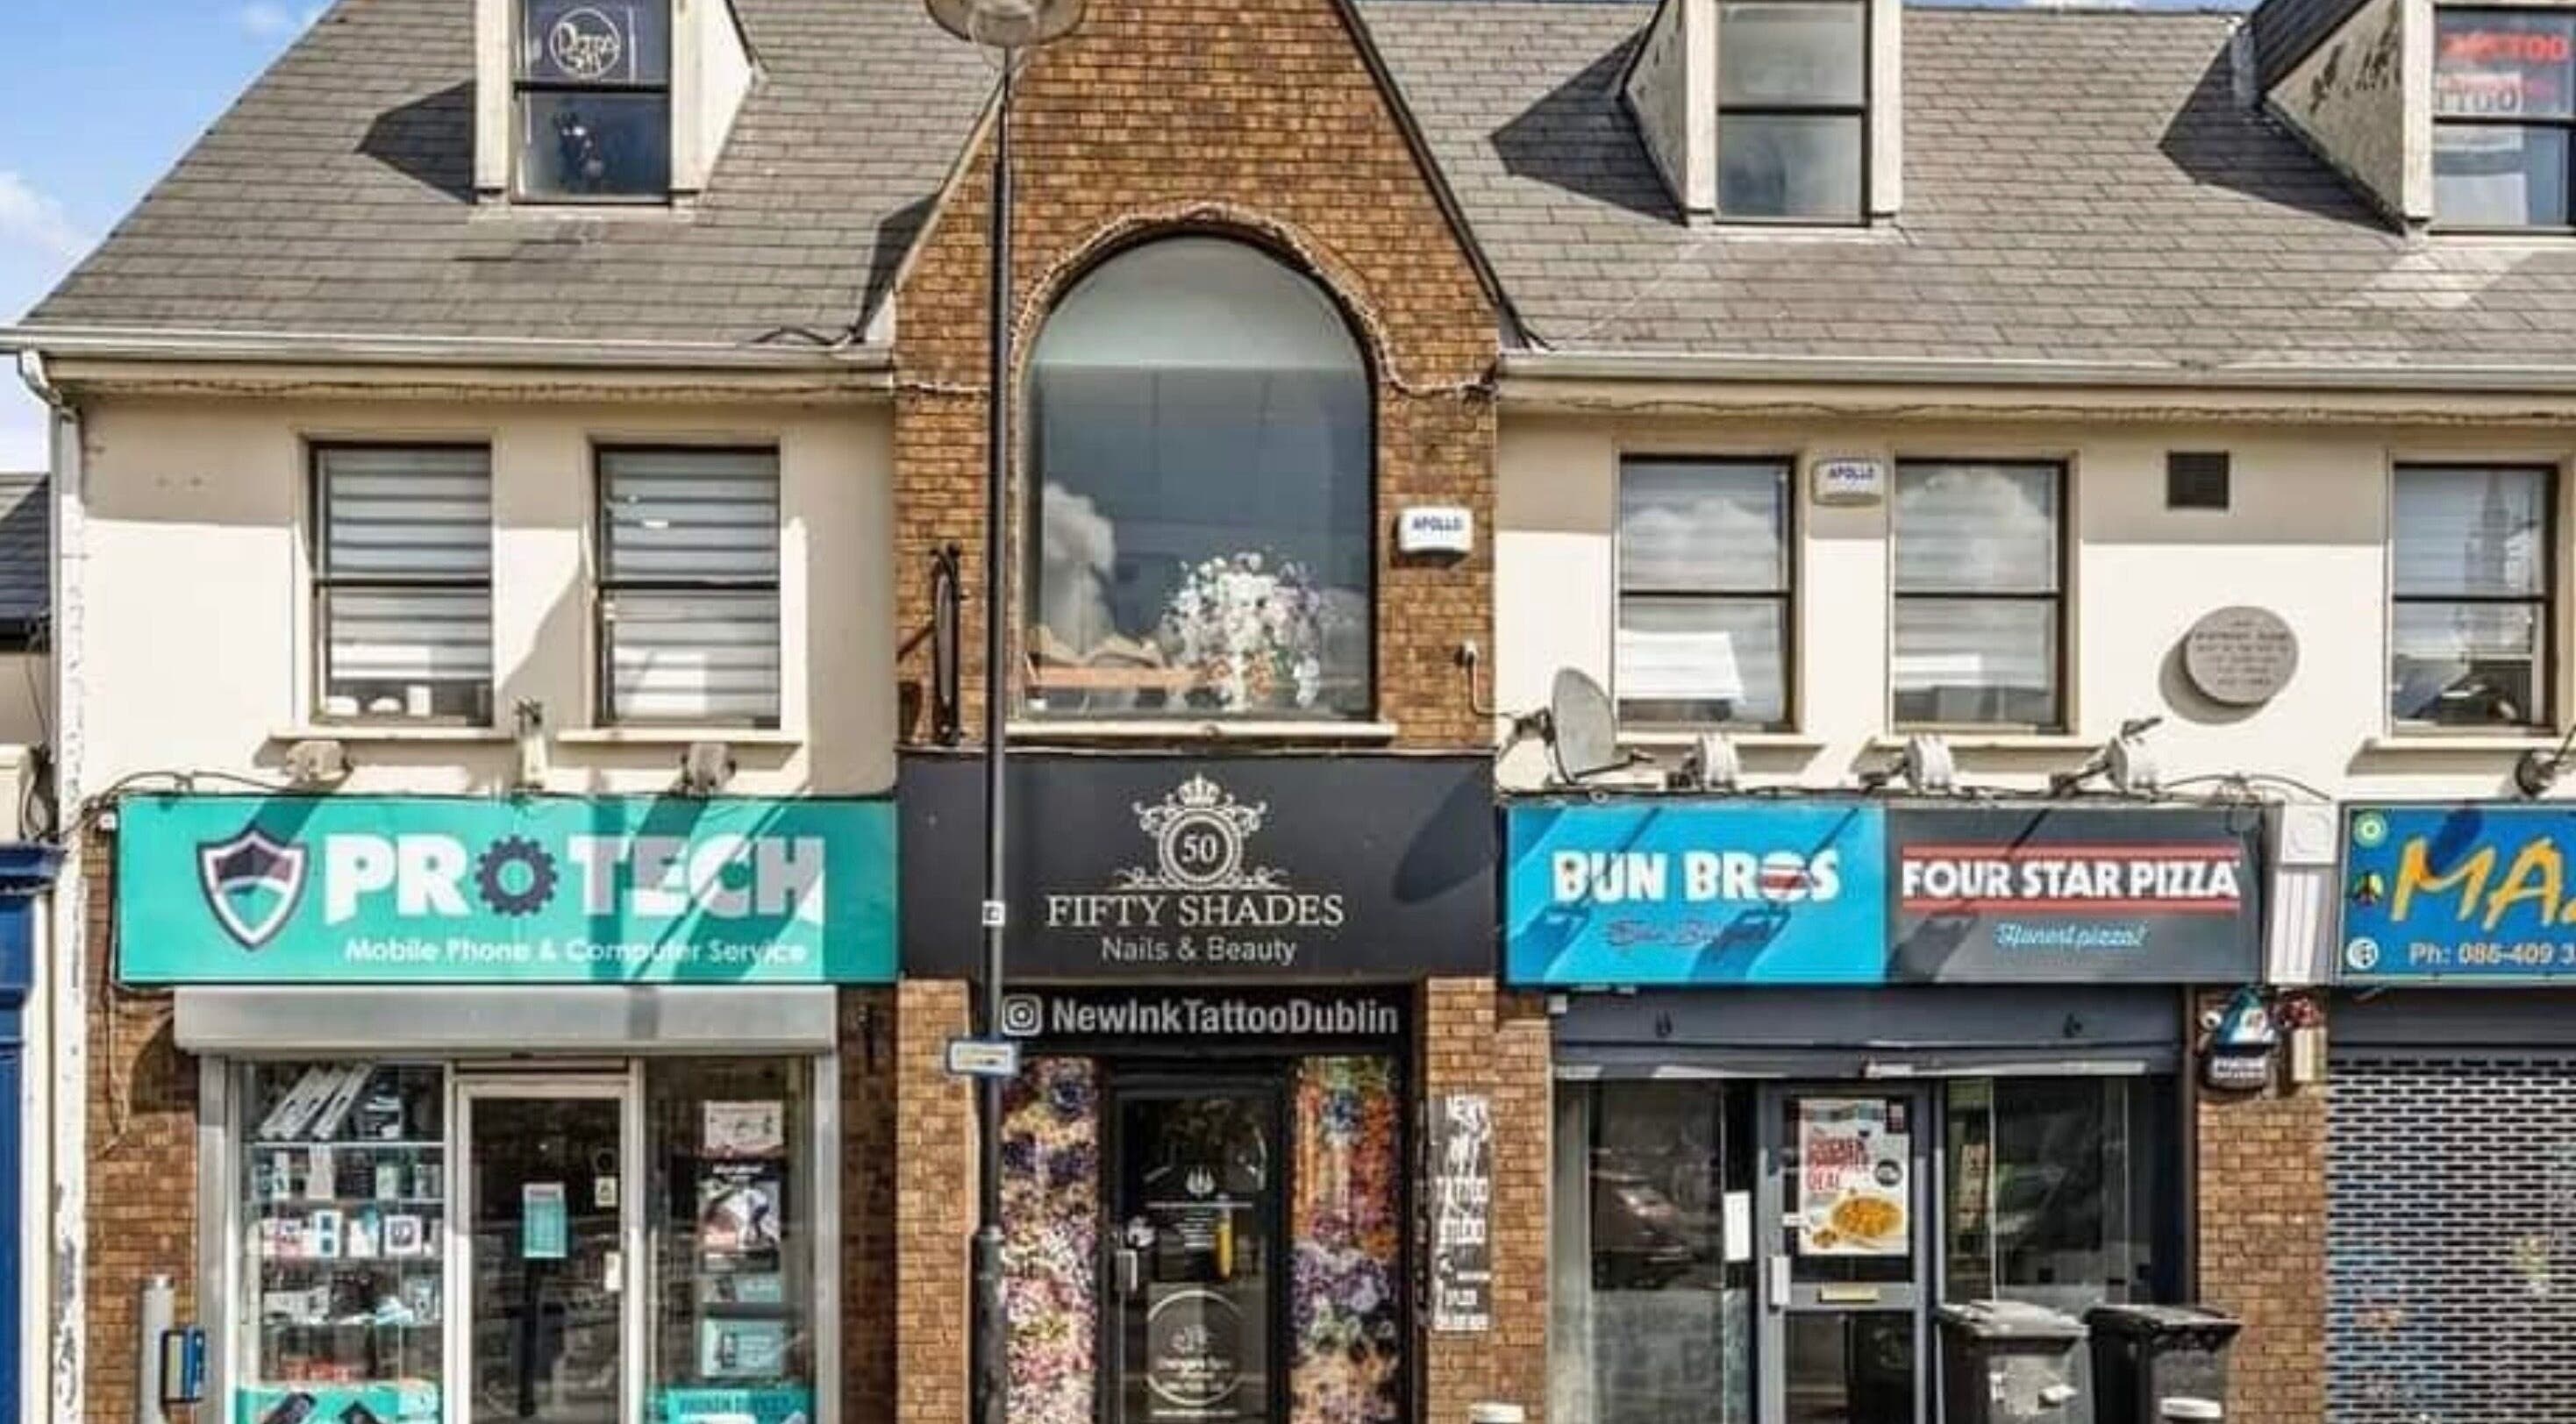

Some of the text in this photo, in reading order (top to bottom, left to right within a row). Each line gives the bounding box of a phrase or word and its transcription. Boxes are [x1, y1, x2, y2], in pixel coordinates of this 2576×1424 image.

[1181, 834, 1217, 863] 50
[1552, 848, 1840, 902] BUN BROS
[1902, 860, 2240, 897] FOUR STAR PIZZA
[1047, 894, 1345, 928] FIFTY SHADES
[345, 937, 807, 968] Mobile Phone & Computer Service
[1102, 936, 1297, 965] Nails & Beauty
[2410, 943, 2450, 965] Ph:
[1053, 999, 1398, 1034] NewInkTattooDublin
